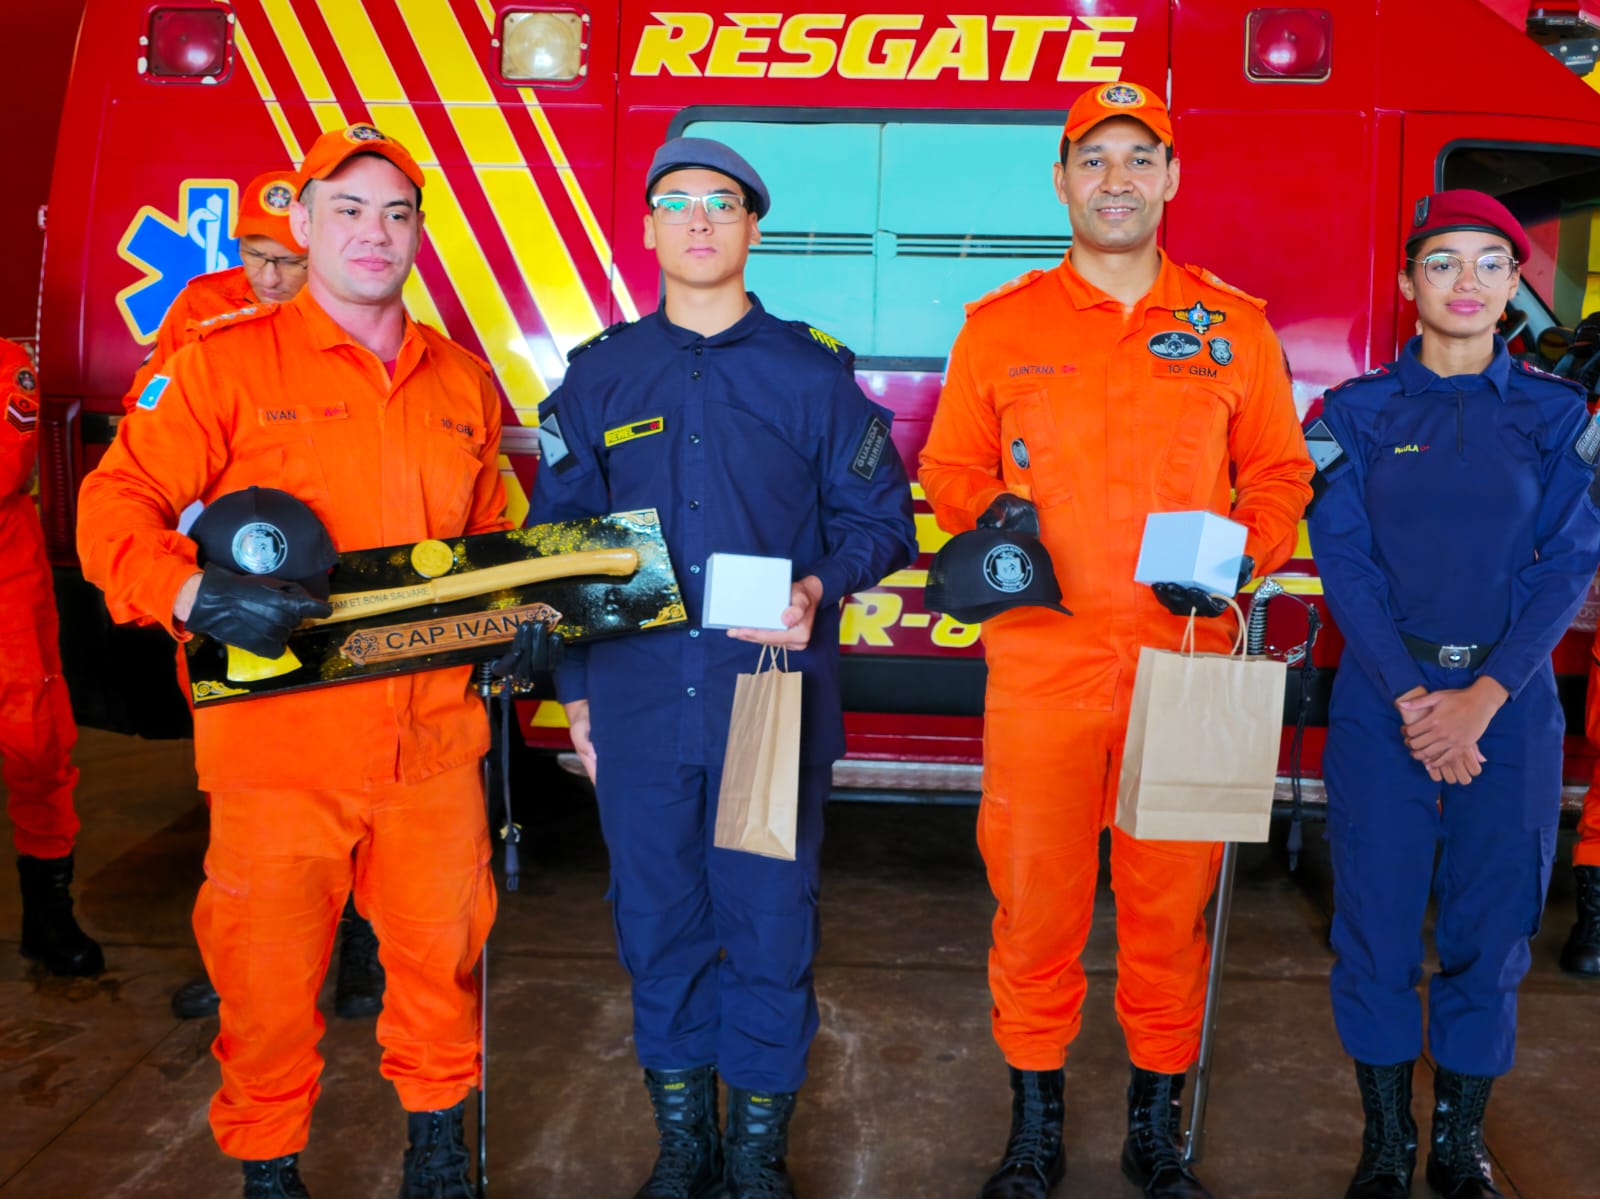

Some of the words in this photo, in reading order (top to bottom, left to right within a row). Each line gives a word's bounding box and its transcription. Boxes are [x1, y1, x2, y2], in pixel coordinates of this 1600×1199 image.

[630, 12, 1137, 82] RESGATE
[1008, 365, 1055, 378] QUINTANA
[1189, 365, 1217, 378] GBM
[265, 410, 296, 421] IVAN
[857, 426, 878, 468] GUARDA
[385, 625, 445, 650] CAP
[456, 613, 520, 640] IVAN
